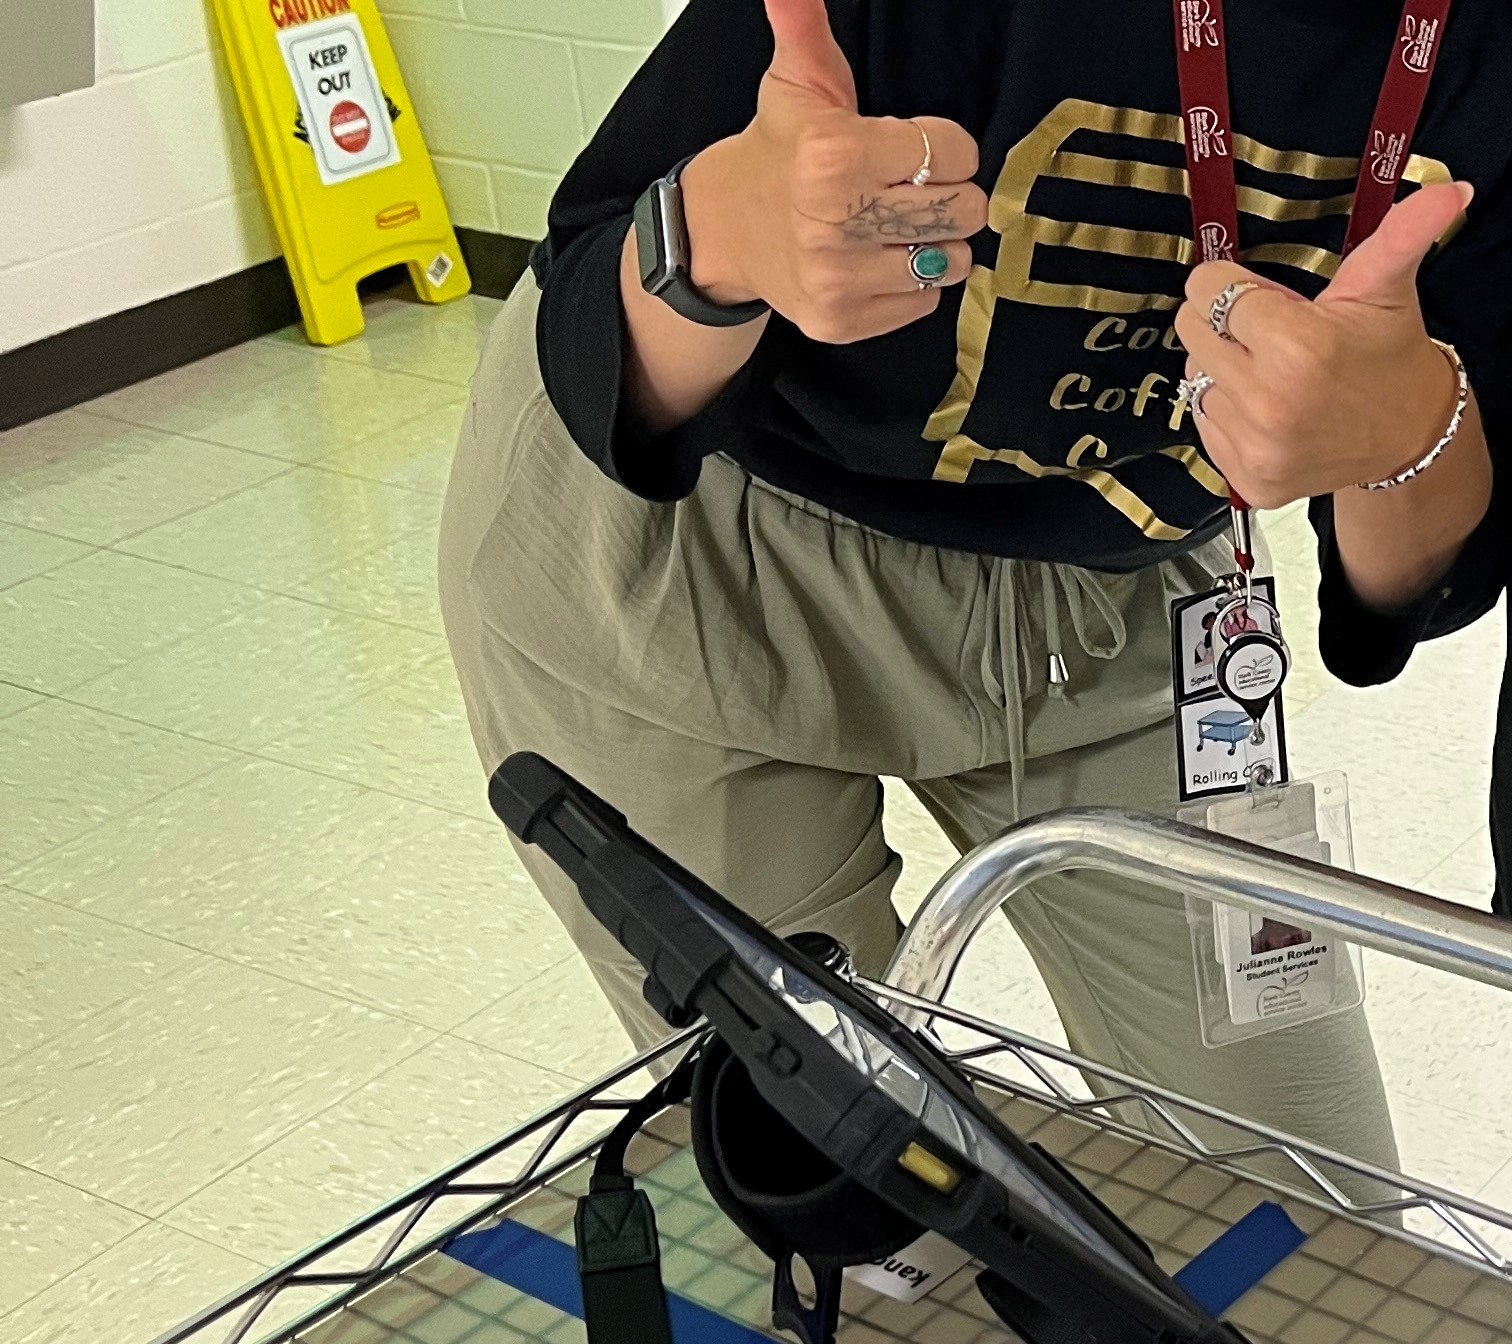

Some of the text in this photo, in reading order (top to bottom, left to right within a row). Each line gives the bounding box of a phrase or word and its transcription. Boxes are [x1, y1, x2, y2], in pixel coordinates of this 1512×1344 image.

[308, 43, 348, 71] KEEP
[317, 69, 352, 96] OUT
[1192, 769, 1239, 787] Rolling
[1236, 954, 1284, 974] Julianne
[1282, 958, 1319, 974] Services
